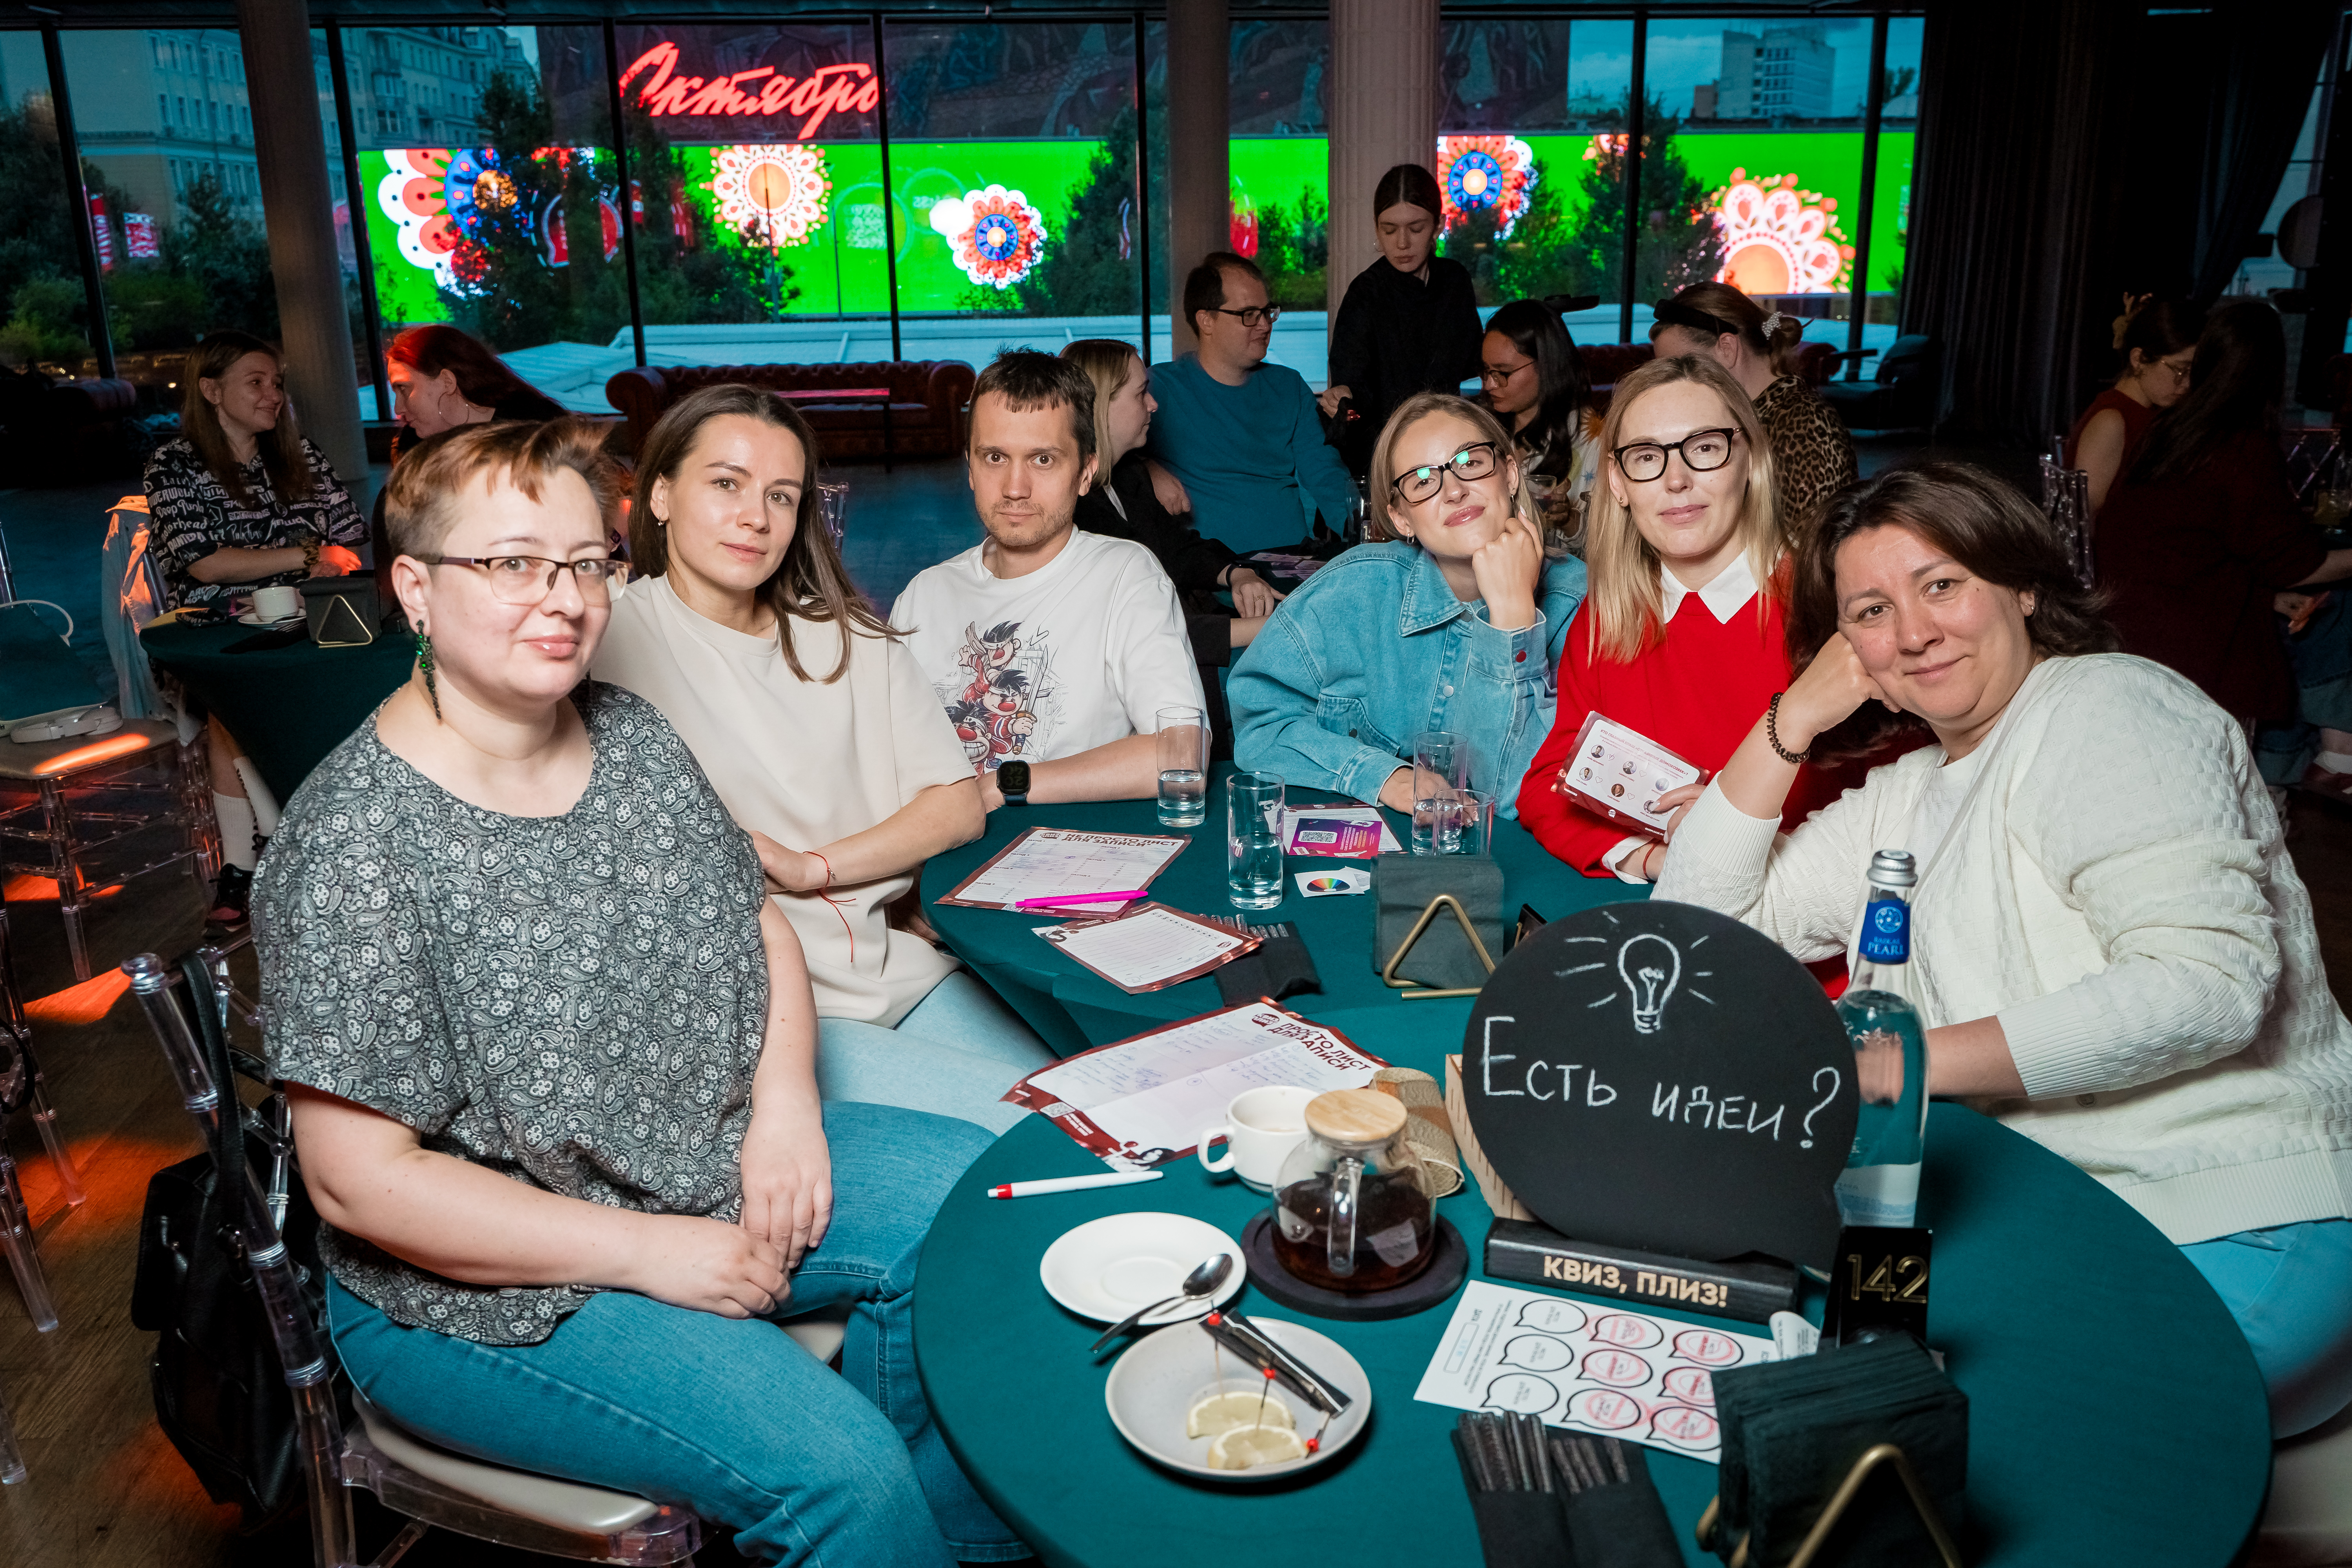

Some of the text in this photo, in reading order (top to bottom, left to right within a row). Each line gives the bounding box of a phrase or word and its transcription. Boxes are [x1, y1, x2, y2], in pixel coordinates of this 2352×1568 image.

[1608, 732, 1625, 744] ГЛАВНЫЙ
[1624, 741, 1636, 750] КРАШ
[1867, 941, 1904, 955] PEARL
[1281, 1023, 1372, 1070] ПРОСТО ЛИСТ
[1295, 1035, 1350, 1071] ЗАПИСИ
[1543, 1255, 1728, 1308] КВИЗ, ПЛИЗ!
[1847, 1254, 1928, 1304] 142
